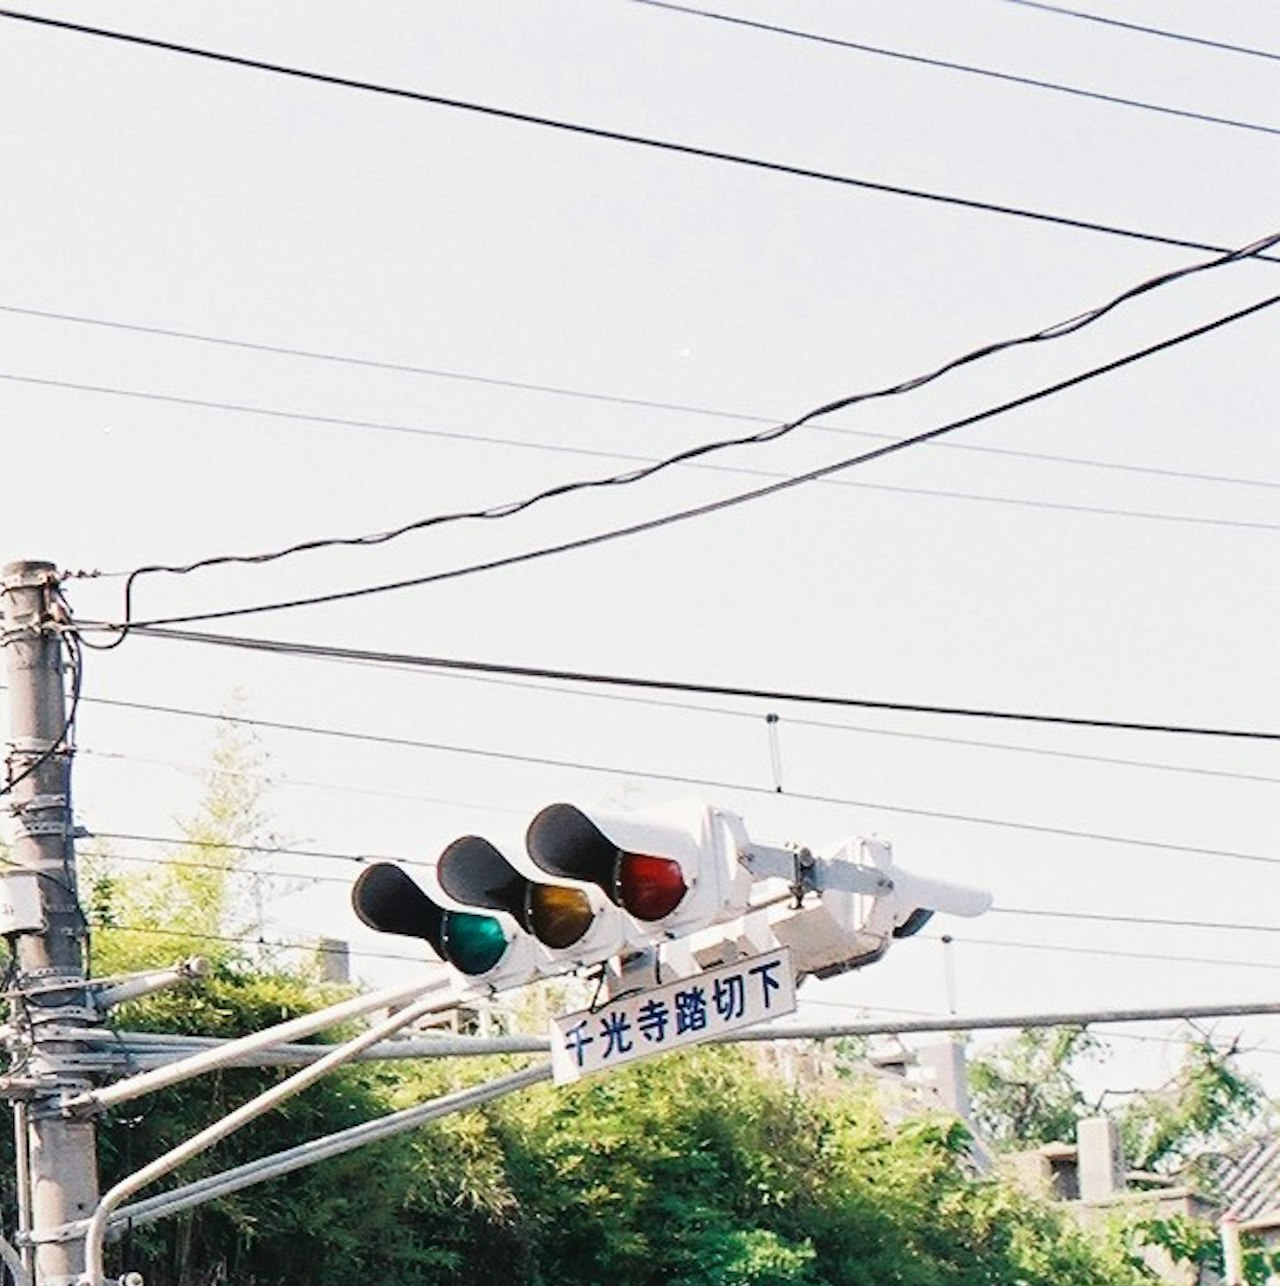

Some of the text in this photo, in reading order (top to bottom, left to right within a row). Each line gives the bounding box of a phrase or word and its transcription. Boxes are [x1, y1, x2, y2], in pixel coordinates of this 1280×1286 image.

[564, 959, 782, 1067] 千光寺踏切下
